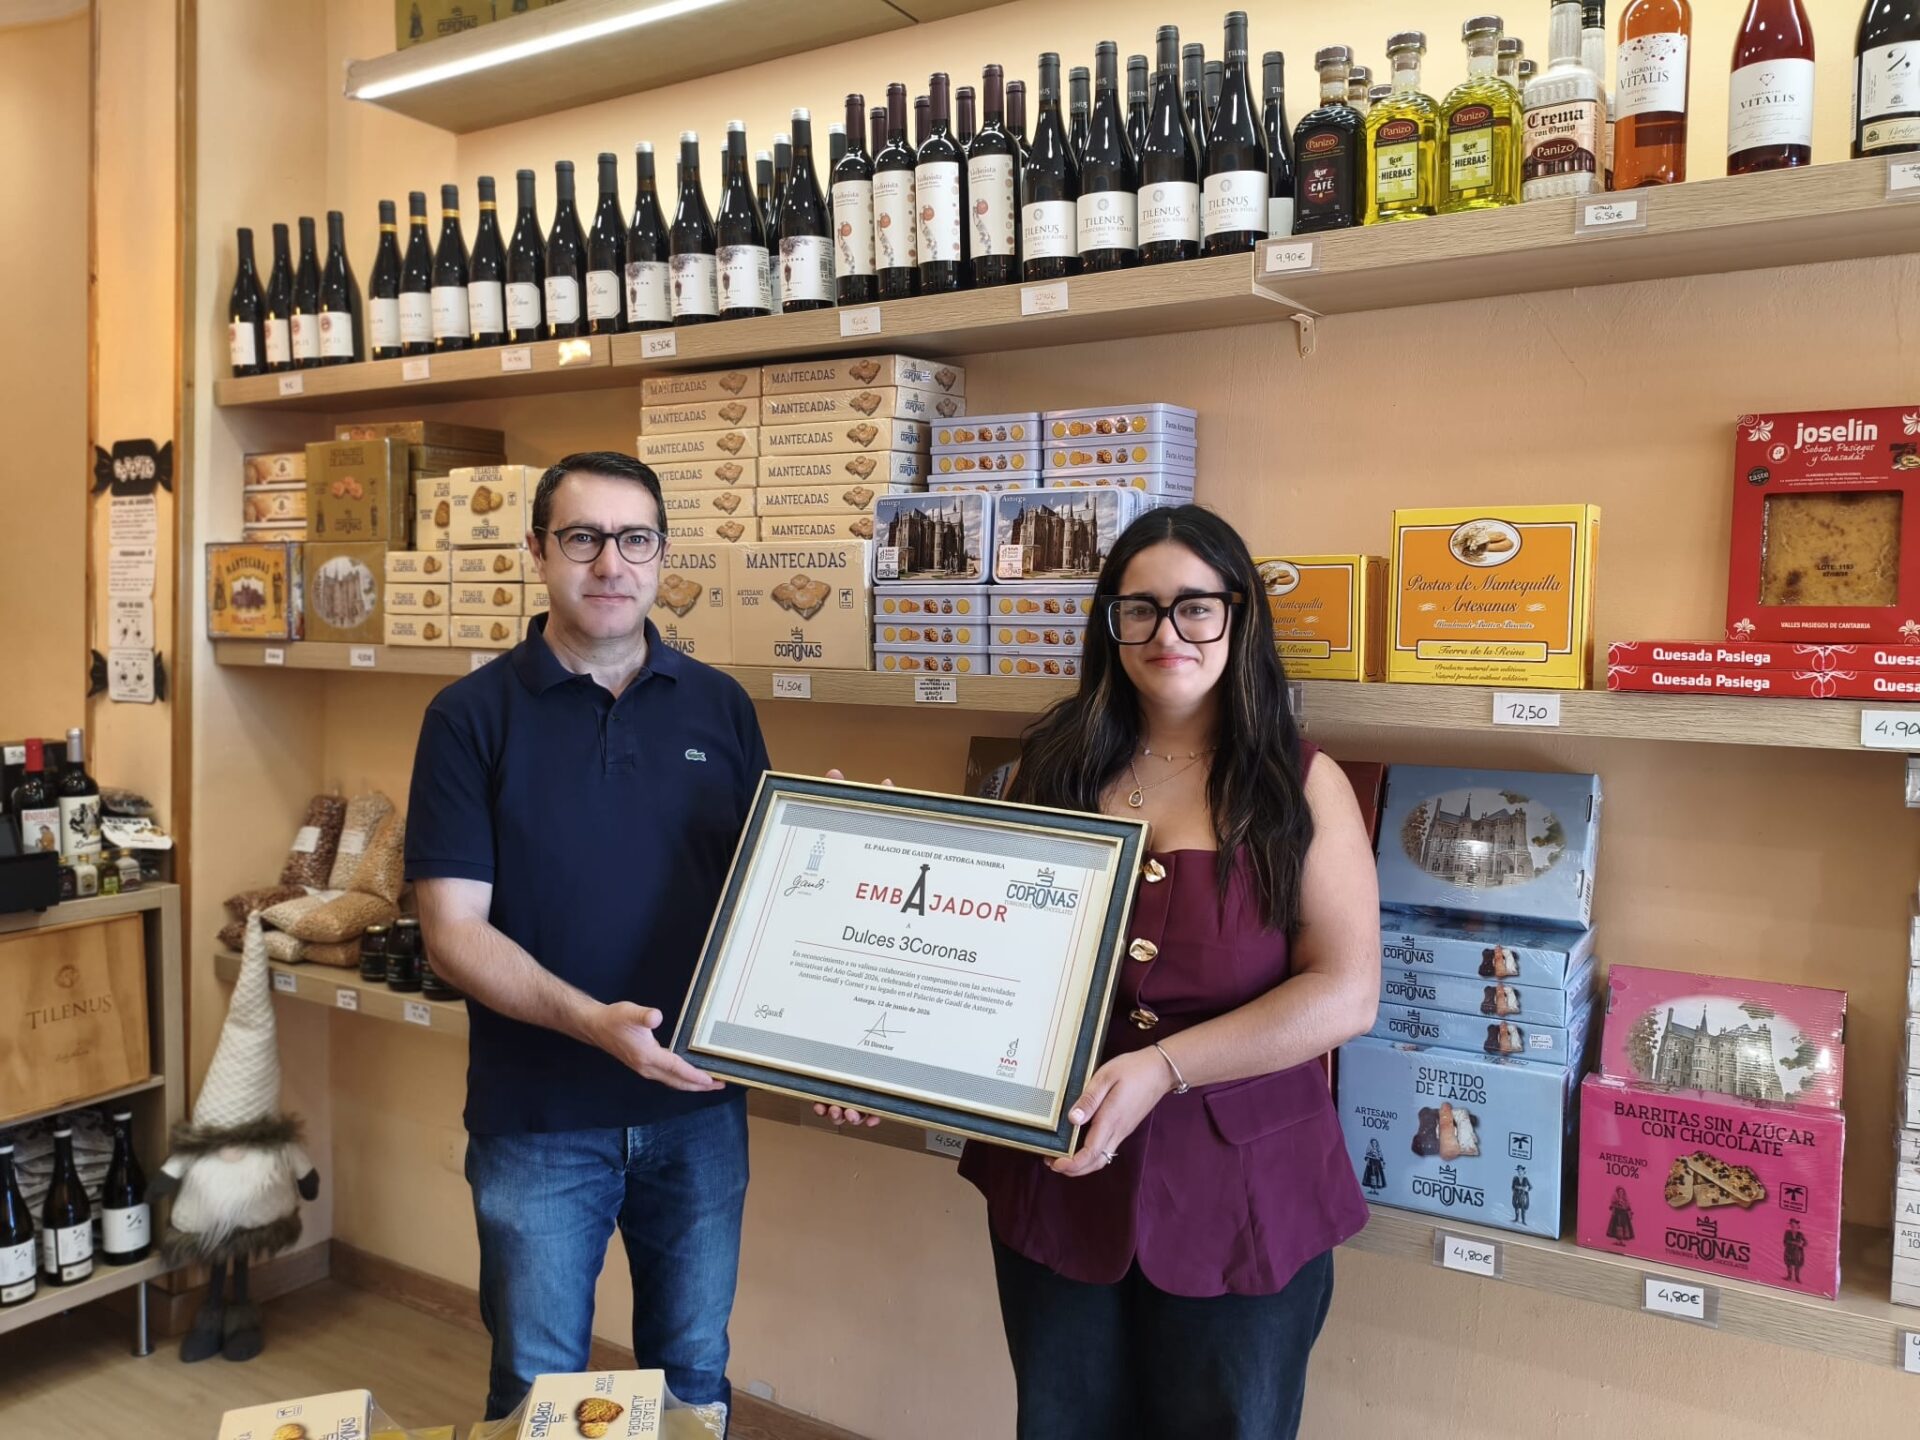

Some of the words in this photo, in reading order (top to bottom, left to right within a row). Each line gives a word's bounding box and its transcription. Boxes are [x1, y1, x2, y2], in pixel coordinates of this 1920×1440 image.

[1619, 70, 1669, 90] VITALIS
[1740, 94, 1795, 110] VITALIS
[1456, 111, 1486, 122] Panizo
[1527, 108, 1584, 129] Crema
[1383, 126, 1411, 136] Panizo
[1309, 138, 1335, 148] Panizo
[1536, 142, 1574, 157] Panizo
[1454, 155, 1487, 168] HIERBAS
[1381, 168, 1412, 180] HIERBAS
[1311, 179, 1333, 192] CAFÉ
[1208, 195, 1249, 209] TILENUS
[1084, 216, 1124, 228] TILENUS
[1142, 206, 1181, 221] TILENUS
[1024, 224, 1059, 238] TILENUS
[771, 368, 836, 384] MANTECADAS
[771, 400, 836, 415] MANTECADAS
[649, 410, 706, 425] MANTECADAS
[769, 431, 833, 446] MANTECADAS
[1794, 418, 1878, 450] joselín
[646, 440, 704, 456] MANTECADAS
[1803, 445, 1832, 454] Sobaos
[768, 464, 832, 478] MANTECADAS
[766, 493, 829, 506] MANTECADAS
[771, 524, 836, 536] MANTECADAS
[663, 553, 717, 570] ECADAS
[746, 552, 847, 569] MANTECADAS
[1405, 574, 1452, 591] Pastas
[1456, 575, 1473, 591] de
[1474, 574, 1562, 597] Mantequilla
[1442, 595, 1518, 612] Artesanas
[774, 644, 822, 662] CORONAS
[1286, 644, 1312, 654] Reina
[1438, 645, 1468, 655] Tierra
[1470, 646, 1481, 655] de
[1483, 646, 1493, 655] la
[1494, 646, 1525, 656] Reina
[1653, 647, 1713, 663] Quesada
[1716, 650, 1771, 665] Pasiega
[1652, 672, 1712, 687] Quesada
[1716, 675, 1770, 690] Pasiega
[1507, 702, 1548, 721] 12,50
[864, 843, 873, 851] EL
[873, 844, 901, 854] PALACIO
[902, 848, 911, 856] DE
[912, 850, 933, 859] GAUDÍ
[943, 855, 975, 864] ASTORGA
[976, 858, 1006, 869] NOMBRA
[1007, 883, 1079, 909] CORONAS
[841, 925, 895, 949] Dulces
[899, 936, 978, 964] 3Coronas
[1383, 947, 1434, 965] CORONAS
[792, 950, 801, 958] En
[801, 952, 845, 966] reconocimiento
[858, 963, 878, 972] valiosa
[878, 966, 916, 979] colaboración
[921, 975, 958, 986] compromiso
[971, 983, 981, 991] las
[981, 985, 1016, 998] actividades
[794, 961, 823, 971] iniciativas
[823, 965, 833, 974] del
[834, 967, 846, 976] Año
[846, 969, 864, 979] Gaudí
[880, 976, 913, 988] celebrando
[920, 984, 953, 996] centenario
[953, 989, 964, 998] del
[964, 991, 1005, 1005] fallecimiento
[1005, 999, 1014, 1007] de
[798, 972, 822, 980] Antonio
[822, 975, 840, 984] Gaudí
[844, 979, 864, 988] Cornet
[878, 985, 898, 995] legado
[914, 992, 935, 1002] Palacio
[944, 998, 963, 1008] Gaudí
[963, 1001, 972, 1009] de
[1386, 983, 1436, 1001] CORONAS
[25, 994, 113, 1030] TILENUS
[892, 1003, 908, 1011] junio
[1389, 1020, 1439, 1039] CORONAS
[870, 1040, 895, 1051] Director
[1418, 1066, 1484, 1090] SURTIDO
[1416, 1080, 1434, 1094] DE
[1438, 1085, 1487, 1104] LAZOS
[1355, 1106, 1398, 1120] ARTESANO
[1362, 1116, 1390, 1131] 100%
[1613, 1101, 1700, 1128] BARRITAS
[1704, 1116, 1733, 1133] SIN
[1737, 1122, 1816, 1147] AZÚCAR
[1641, 1121, 1675, 1139] CON
[1679, 1127, 1783, 1157] CHOCOLATE
[1598, 1152, 1648, 1168] ARTESANO
[1605, 1162, 1640, 1179] 100%
[1412, 1180, 1484, 1207] CORONAS
[1665, 1231, 1751, 1263] CORONAS
[627, 1394, 644, 1438] ALMENDRA
[642, 1398, 657, 1421] TEJAS
[529, 1401, 552, 1438] CORONAS
[641, 1421, 654, 1432] DE
